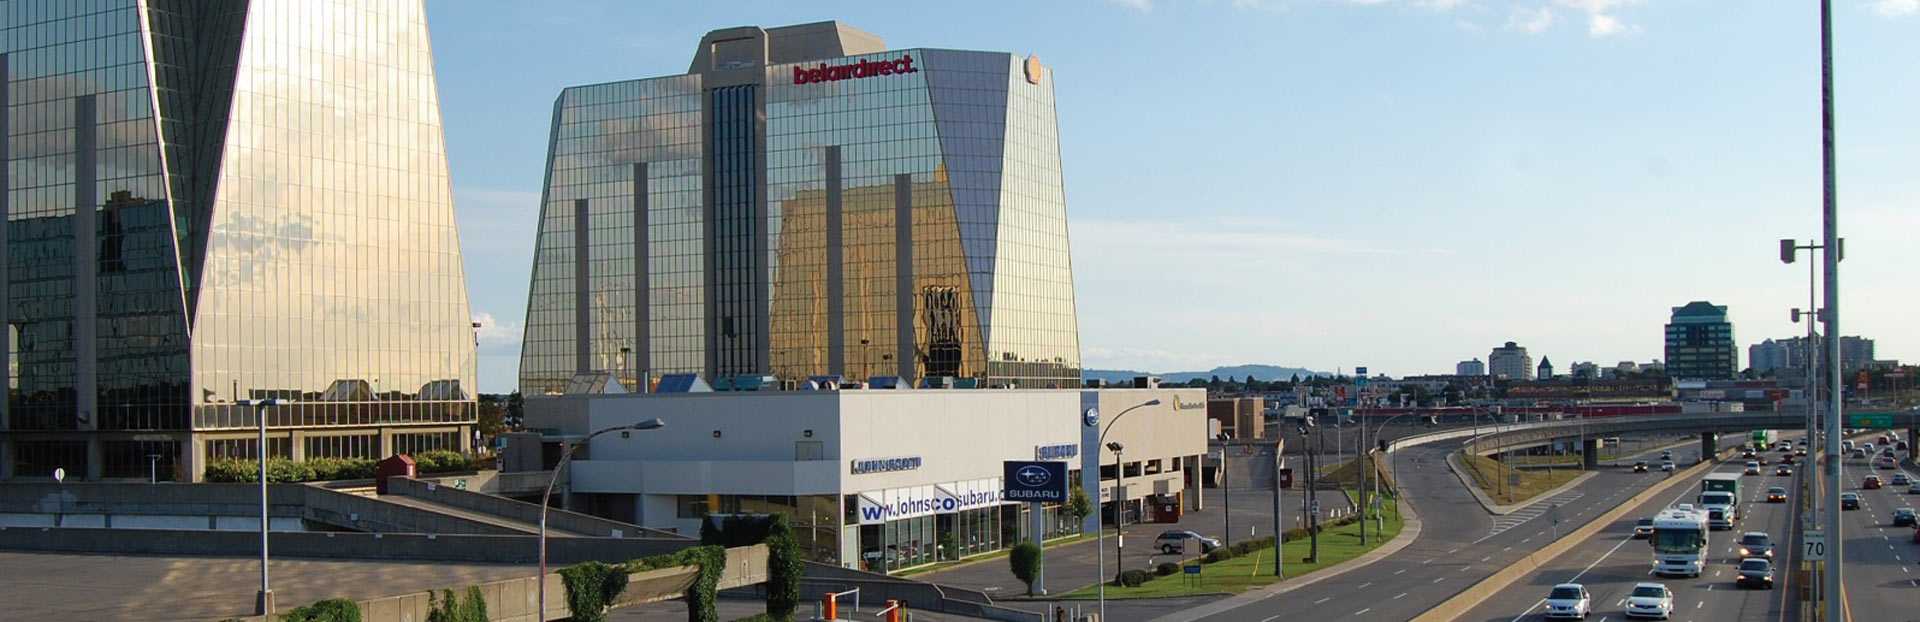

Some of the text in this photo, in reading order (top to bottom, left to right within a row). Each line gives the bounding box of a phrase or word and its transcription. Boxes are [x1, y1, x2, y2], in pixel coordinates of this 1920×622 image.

[1039, 444, 1078, 459] SUBARU
[1009, 490, 1060, 498] SUBARU
[1806, 542, 1824, 556] 70
